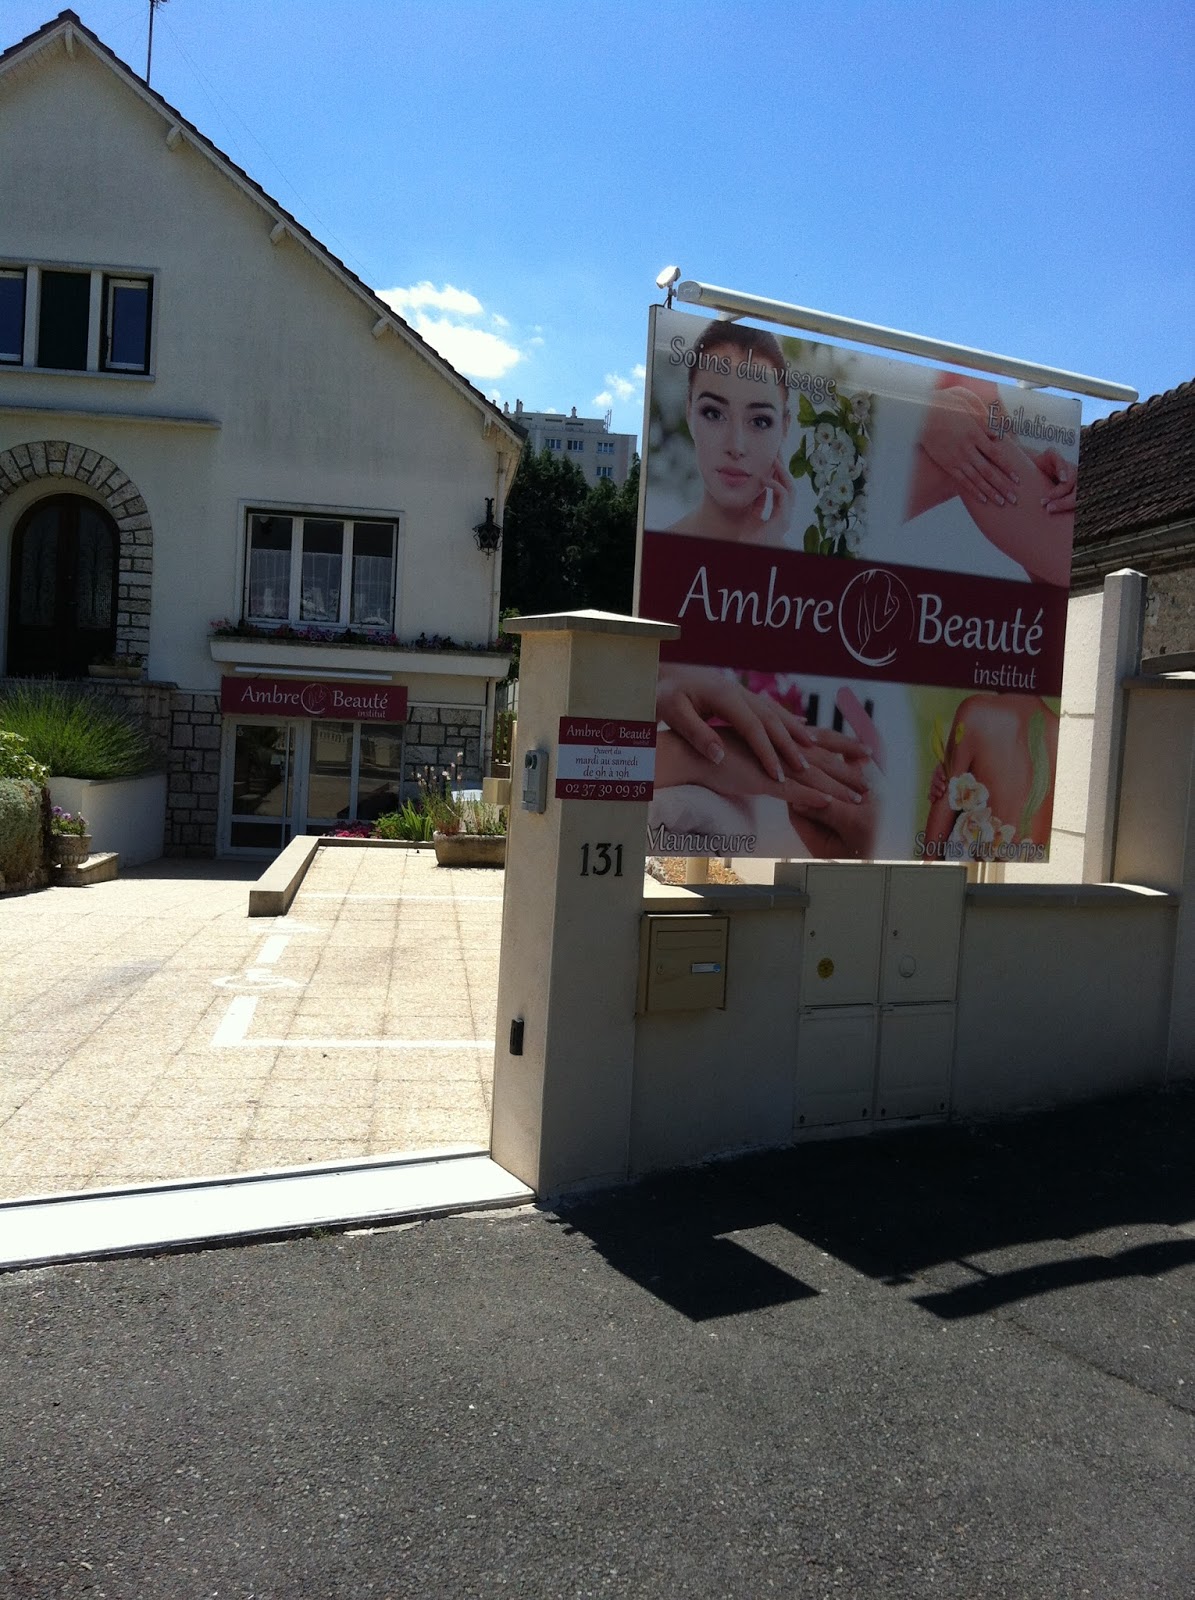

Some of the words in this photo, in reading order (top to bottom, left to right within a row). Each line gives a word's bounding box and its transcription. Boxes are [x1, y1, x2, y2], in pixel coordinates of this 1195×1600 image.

[670, 336, 732, 375] Soins
[737, 348, 767, 383] du
[772, 362, 837, 405] visage
[988, 400, 1076, 446] Épilations
[678, 565, 834, 634] Ambre
[916, 593, 1044, 656] Beauté
[973, 661, 1037, 690] institut
[241, 684, 300, 705] Ambre
[333, 690, 389, 711] Beauté
[357, 709, 386, 719] institut
[565, 723, 601, 738] Ambre
[619, 726, 651, 740] Beauté
[575, 755, 599, 765] mardi
[612, 756, 638, 766] samedi
[593, 747, 613, 756] Ouvert
[613, 747, 622, 755] du
[583, 766, 594, 777] de
[595, 766, 607, 780] 9h
[608, 768, 614, 778] à
[616, 767, 630, 780] 19h
[565, 783, 579, 793] 02
[581, 784, 597, 797] 37
[598, 784, 613, 798] 30
[615, 785, 630, 798] 09
[632, 782, 647, 798] 36
[646, 822, 757, 853] Manucure
[914, 830, 964, 859] Soins
[968, 830, 996, 859] du
[996, 841, 1046, 862] corps
[580, 842, 624, 877] 131
